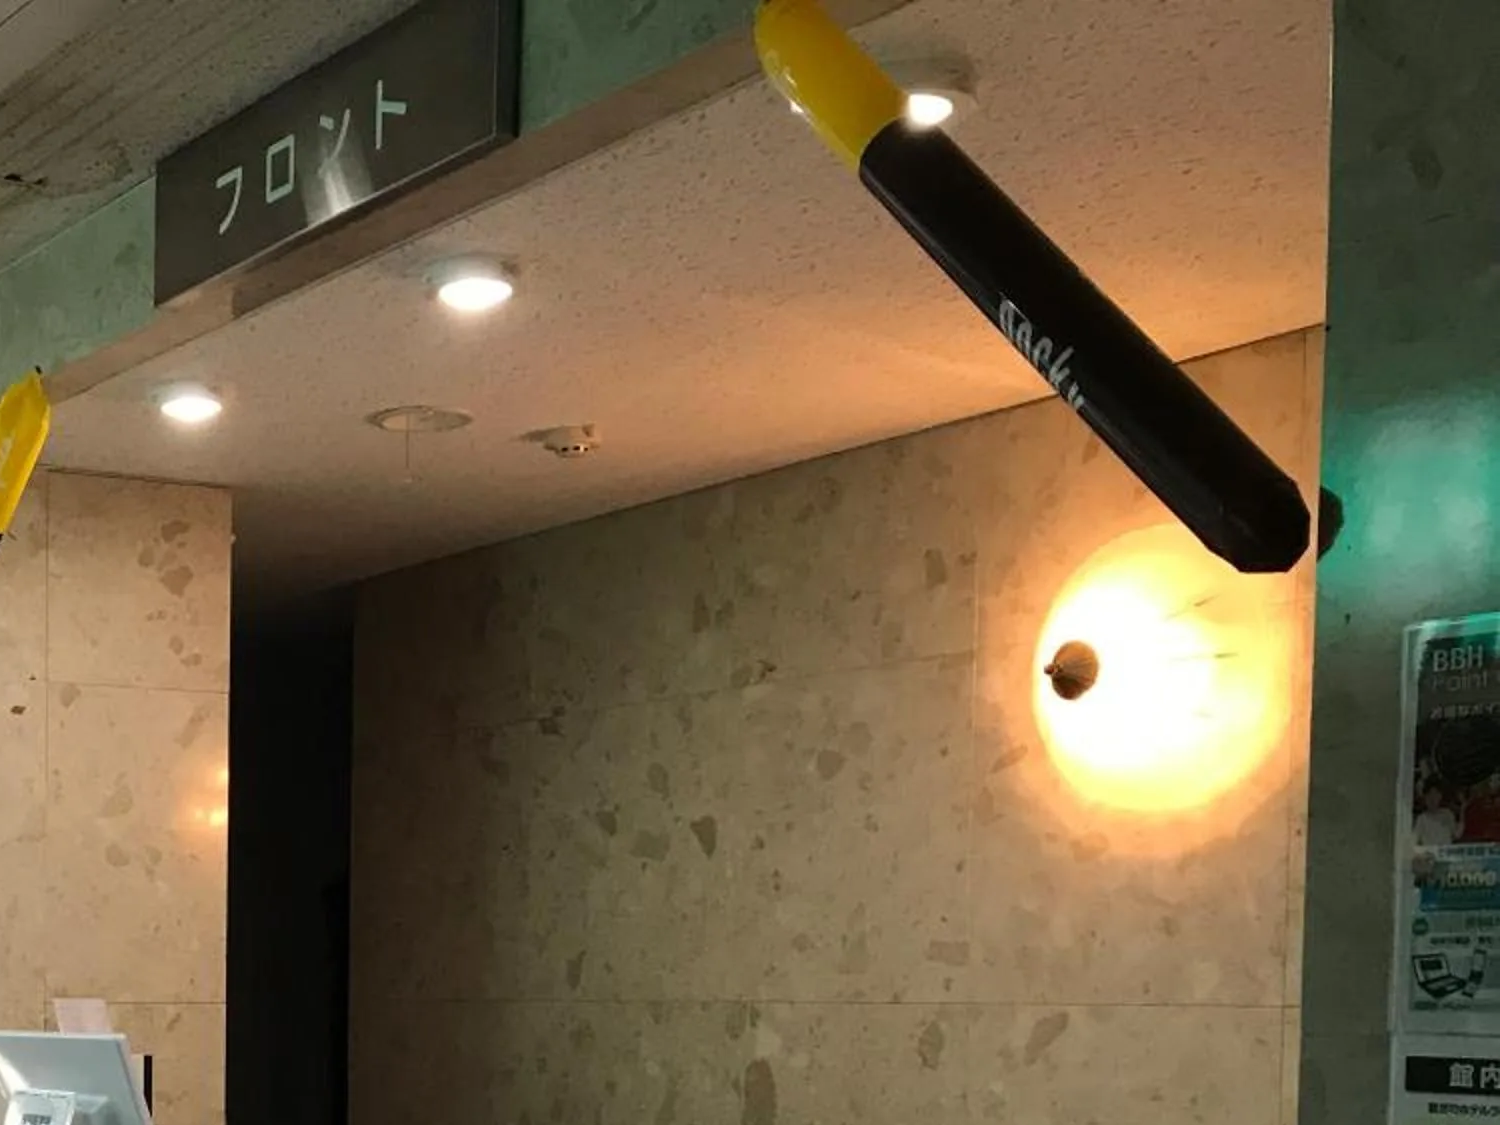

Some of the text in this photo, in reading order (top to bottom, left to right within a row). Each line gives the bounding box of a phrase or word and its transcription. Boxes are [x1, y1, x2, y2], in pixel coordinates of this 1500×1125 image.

[215, 79, 408, 235] フロント
[1432, 644, 1484, 673] BBH
